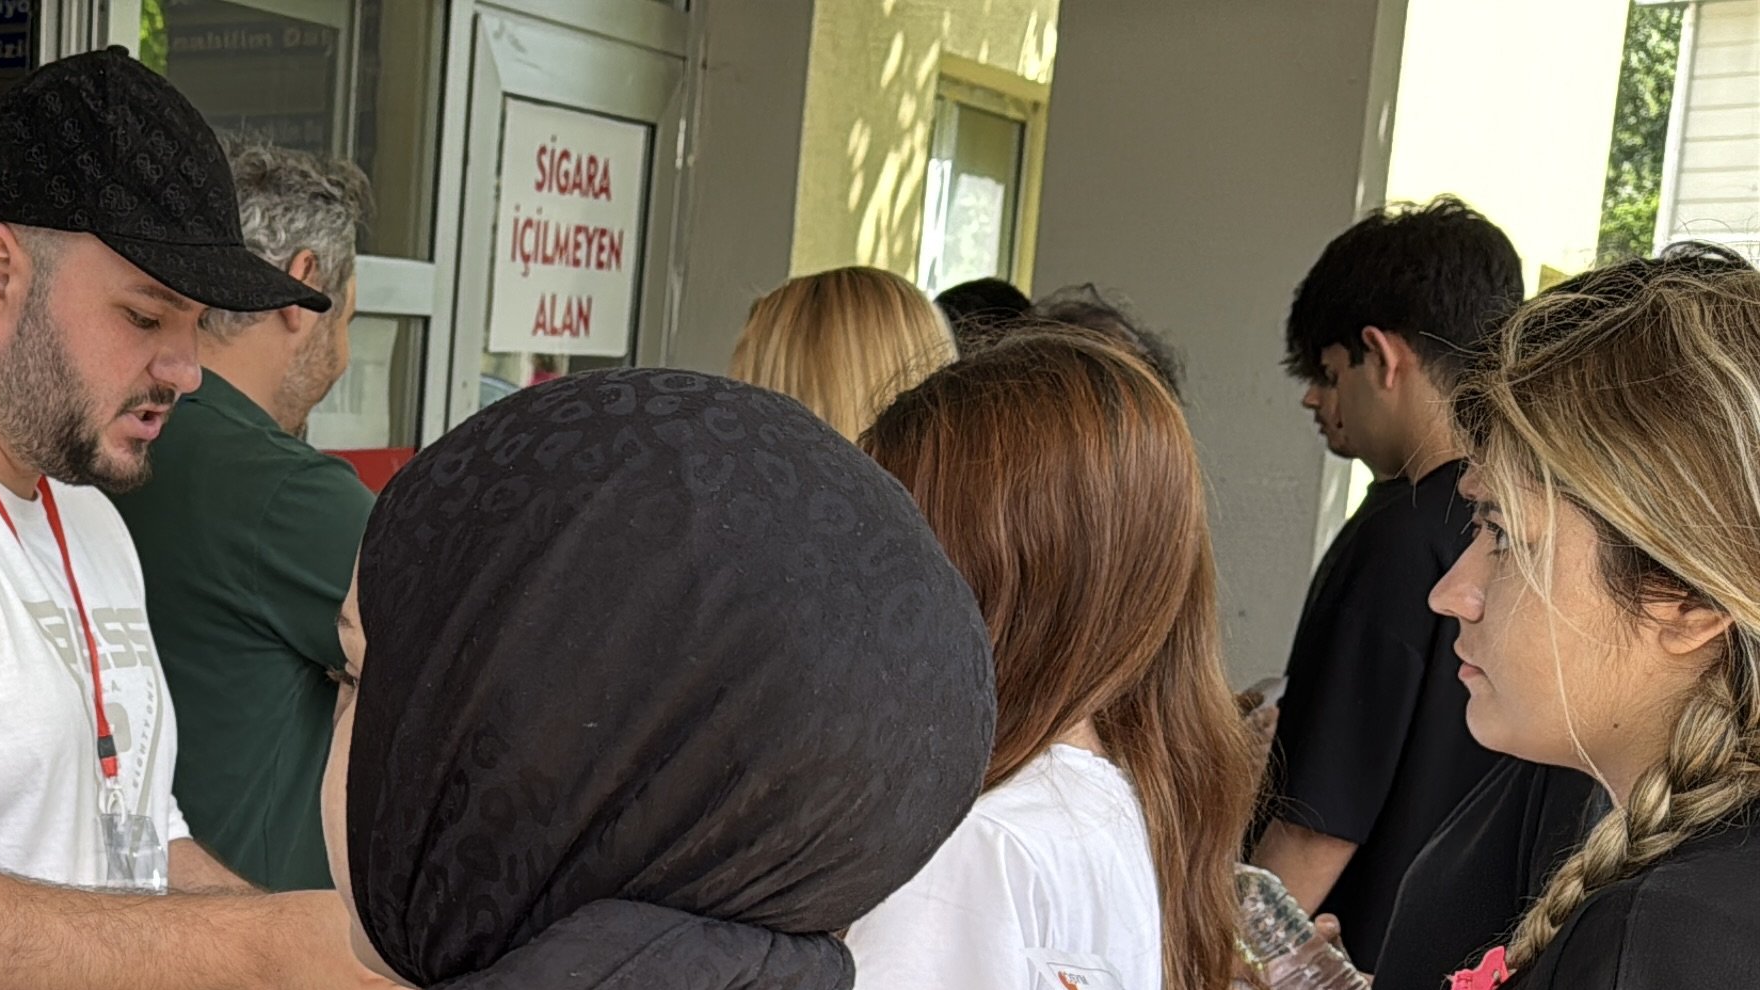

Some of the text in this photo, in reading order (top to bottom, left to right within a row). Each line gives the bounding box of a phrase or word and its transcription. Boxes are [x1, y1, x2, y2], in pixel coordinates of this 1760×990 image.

[174, 28, 274, 51] nabilim
[534, 134, 612, 202] SİGARA
[510, 203, 625, 278] İÇİLMEYEN
[531, 293, 593, 338] ALAN
